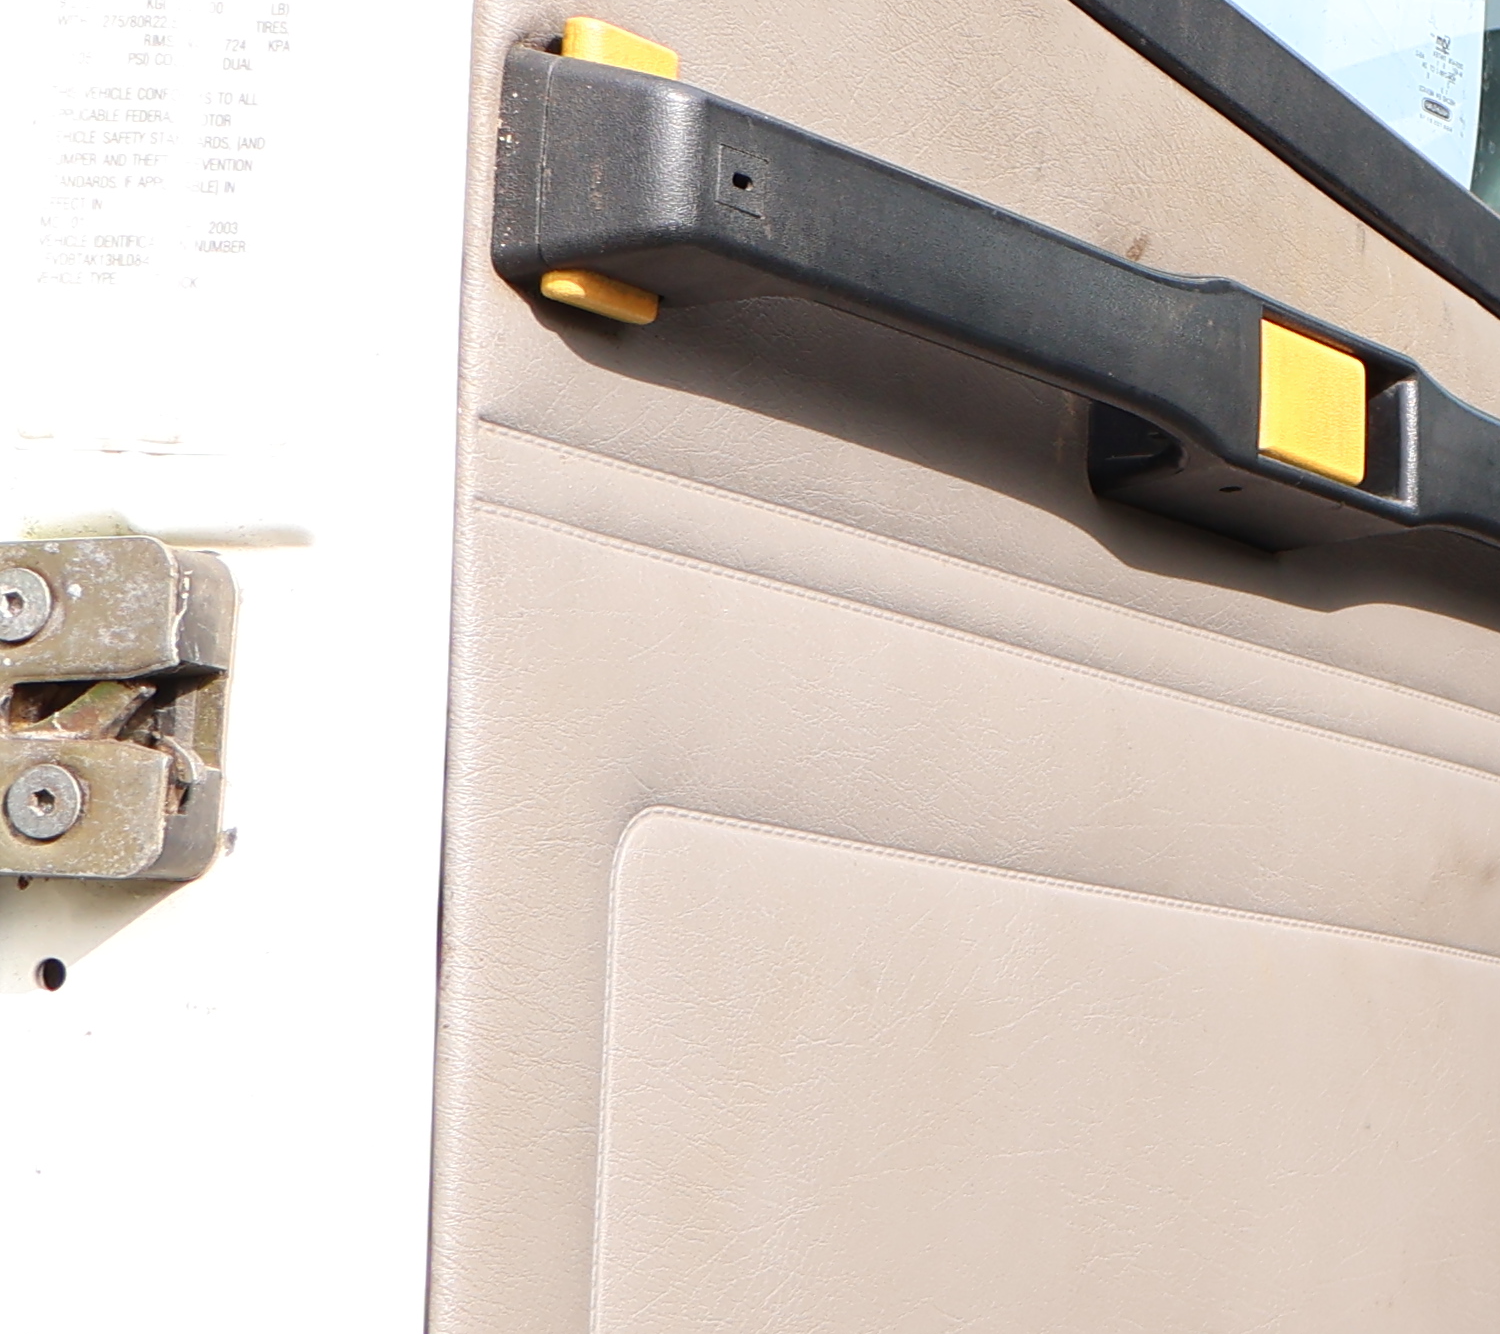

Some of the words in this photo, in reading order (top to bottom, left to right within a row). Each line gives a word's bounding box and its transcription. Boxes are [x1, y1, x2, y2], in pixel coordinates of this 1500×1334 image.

[271, 3, 290, 17] LB)
[225, 39, 246, 52] 724
[268, 40, 290, 52] KPA
[223, 57, 253, 71] DUAL
[218, 92, 233, 105] TO
[238, 93, 258, 106] ALL
[103, 131, 146, 145] SAFETY
[102, 154, 127, 166] AND
[124, 176, 132, 188] IF
[224, 181, 235, 193] IN
[92, 198, 102, 210] IN
[208, 221, 238, 235] 2003
[90, 272, 116, 285] TYPE
